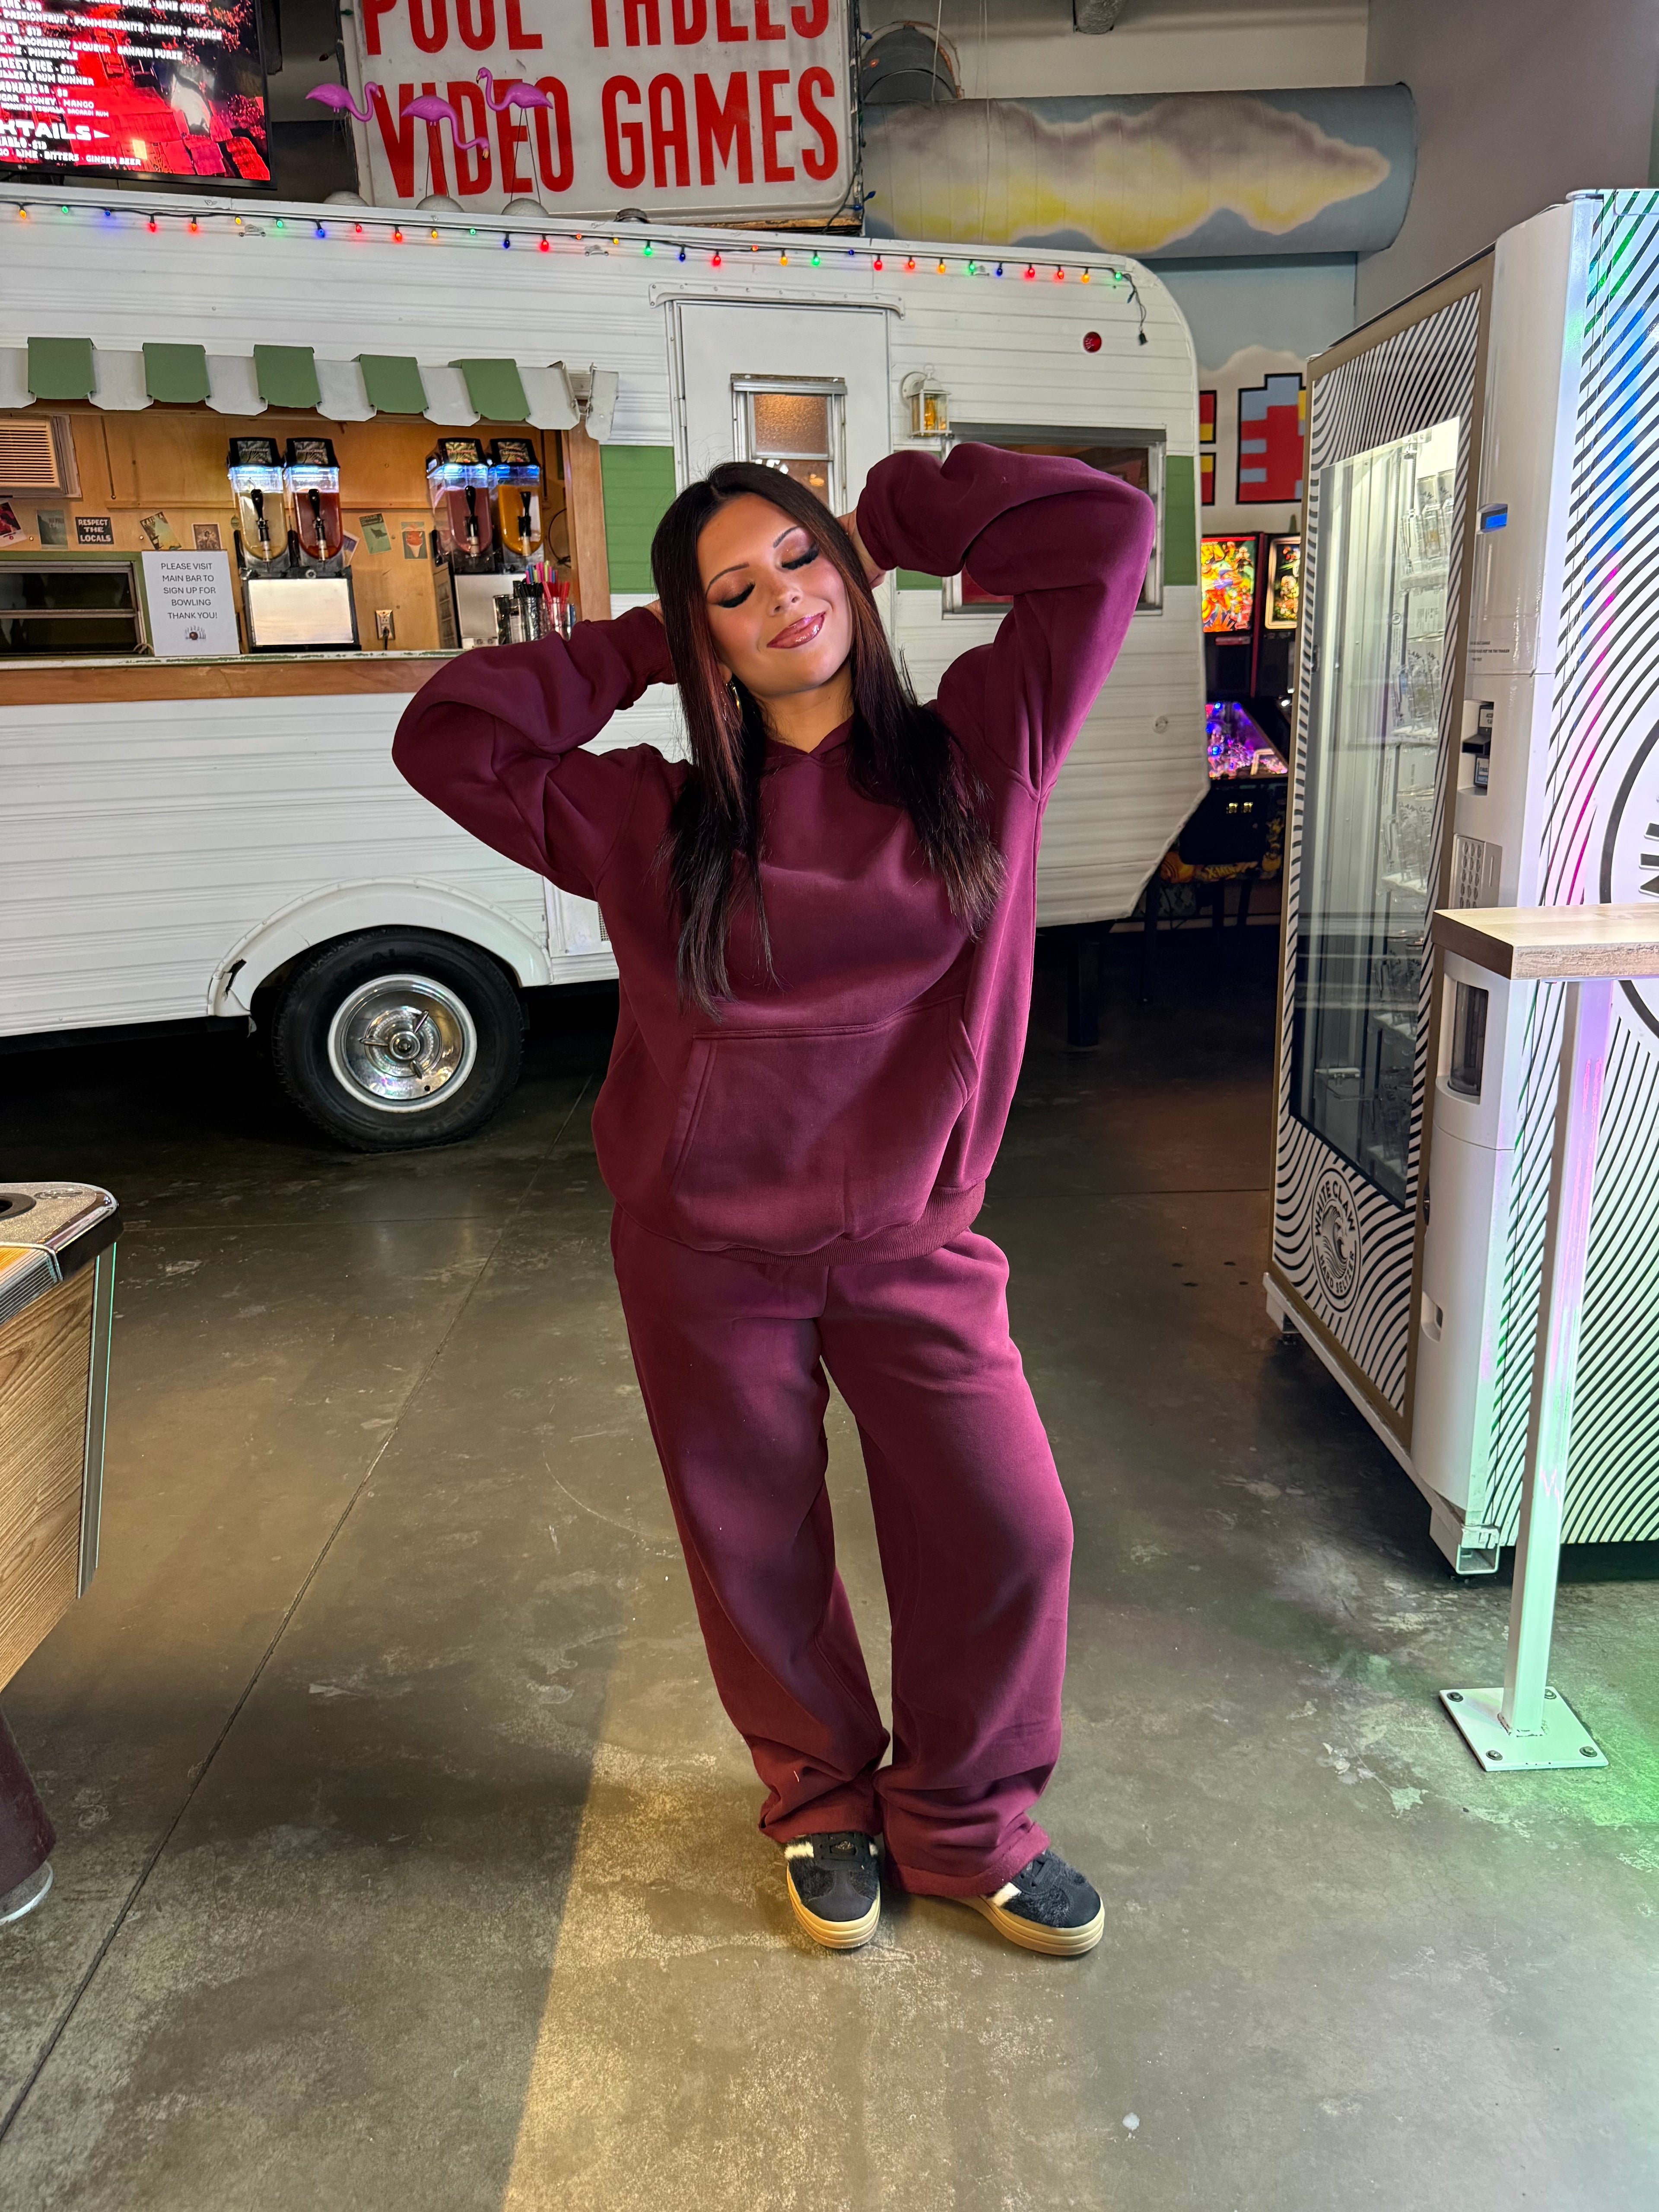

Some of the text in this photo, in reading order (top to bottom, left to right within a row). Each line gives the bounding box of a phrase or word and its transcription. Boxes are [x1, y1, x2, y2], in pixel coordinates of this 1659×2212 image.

[0, 0, 21, 9] ANE
[179, 2, 206, 14] JUICE
[3, 9, 68, 24] PASSIONFRUIT
[150, 23, 181, 36] LEMON
[187, 27, 222, 40] ORANGE
[13, 35, 70, 49] BLACKBERRY
[117, 45, 153, 58] BANANA
[154, 48, 183, 60] PUREE
[28, 47, 78, 60] PINEAPPLE
[29, 59, 53, 72] VICE
[36, 73, 55, 83] RUM
[57, 74, 94, 86] RUNNER
[0, 94, 94, 108] GAR HONEY MANGO
[374, 66, 839, 197] VIDEO GAMES
[16, 149, 38, 158] LIME
[44, 151, 79, 162] BITTERS
[86, 155, 117, 165] GINGER
[119, 157, 142, 166] BEER
[1315, 1180, 1355, 1236] WHITE CLAW
[1319, 1251, 1354, 1294] HARD SELTZER
